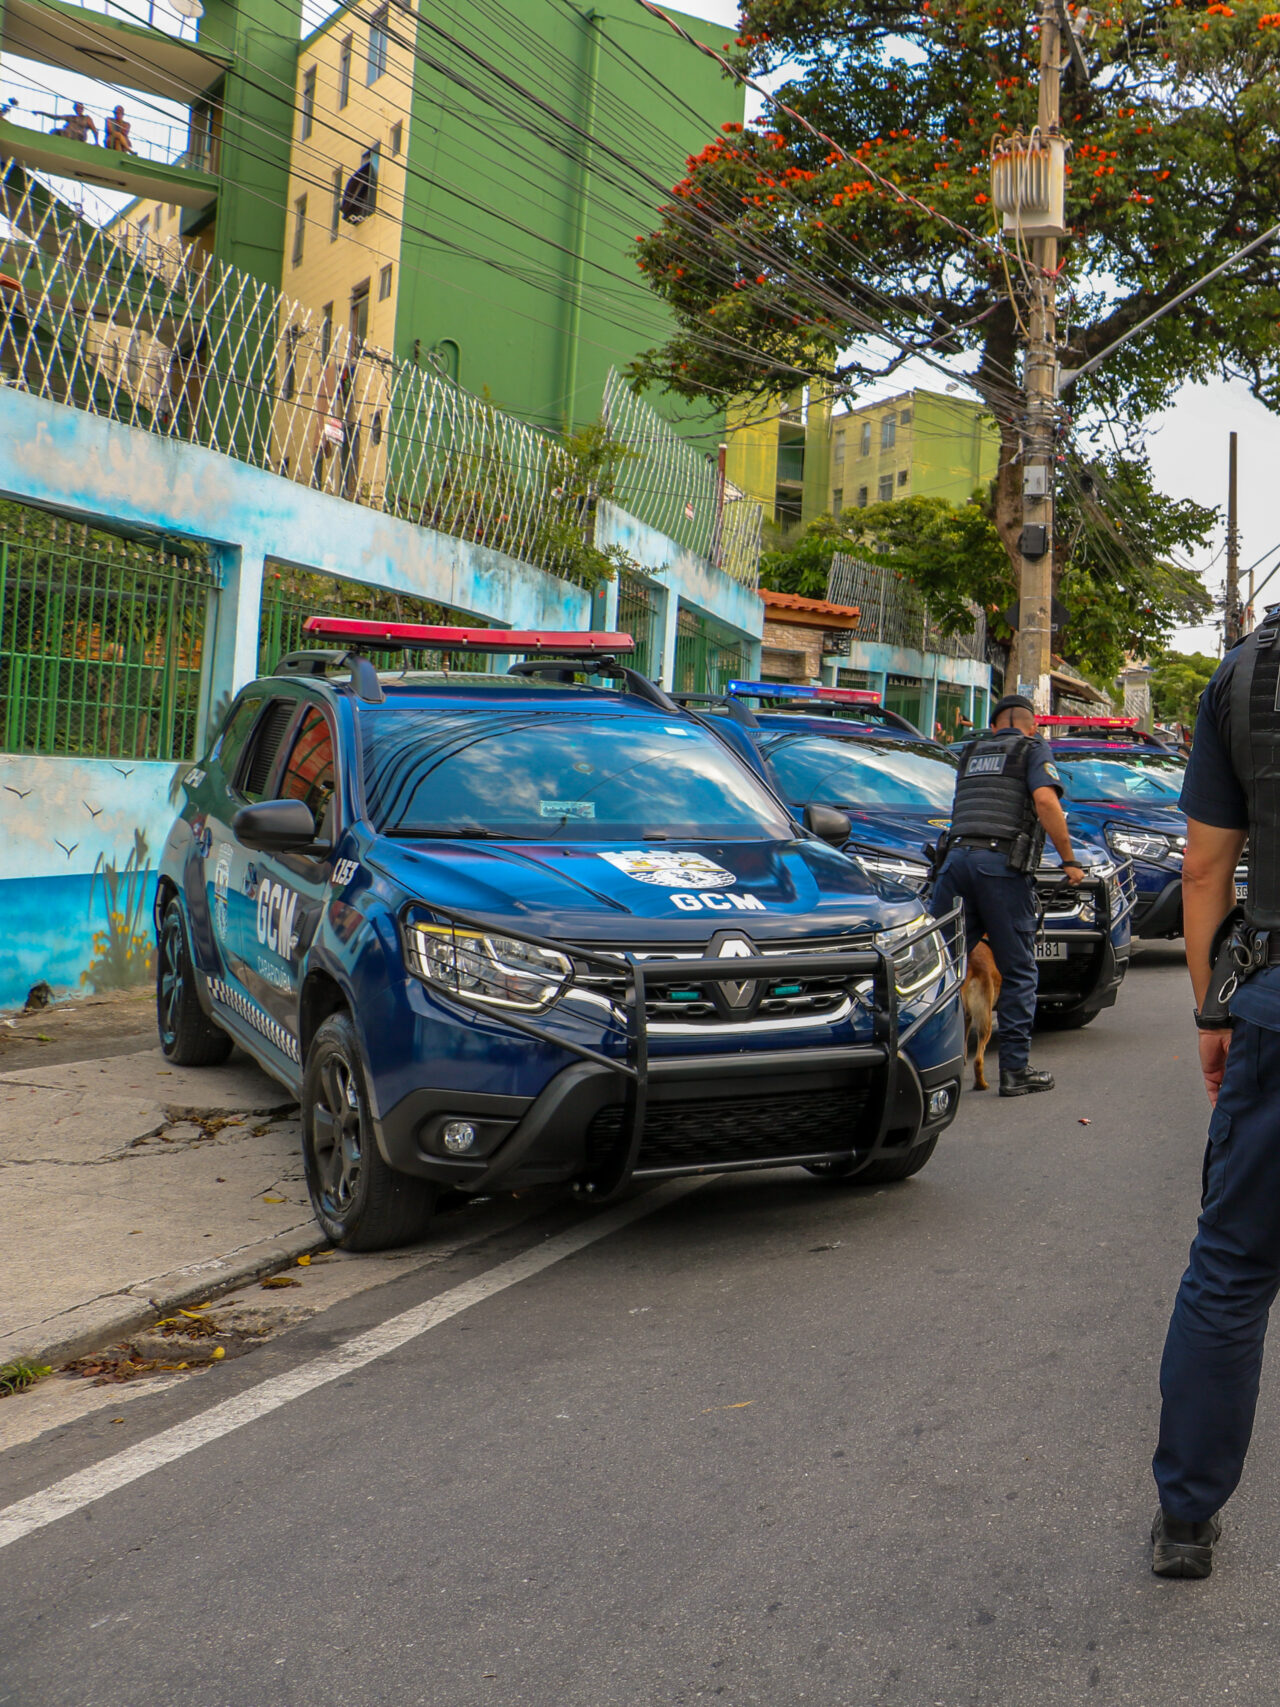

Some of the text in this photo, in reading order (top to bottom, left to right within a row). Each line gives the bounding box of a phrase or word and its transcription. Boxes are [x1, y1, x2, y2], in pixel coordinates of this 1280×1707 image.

[968, 757, 1001, 773] CANIL
[669, 892, 767, 912] GCM
[256, 877, 299, 961] GCM
